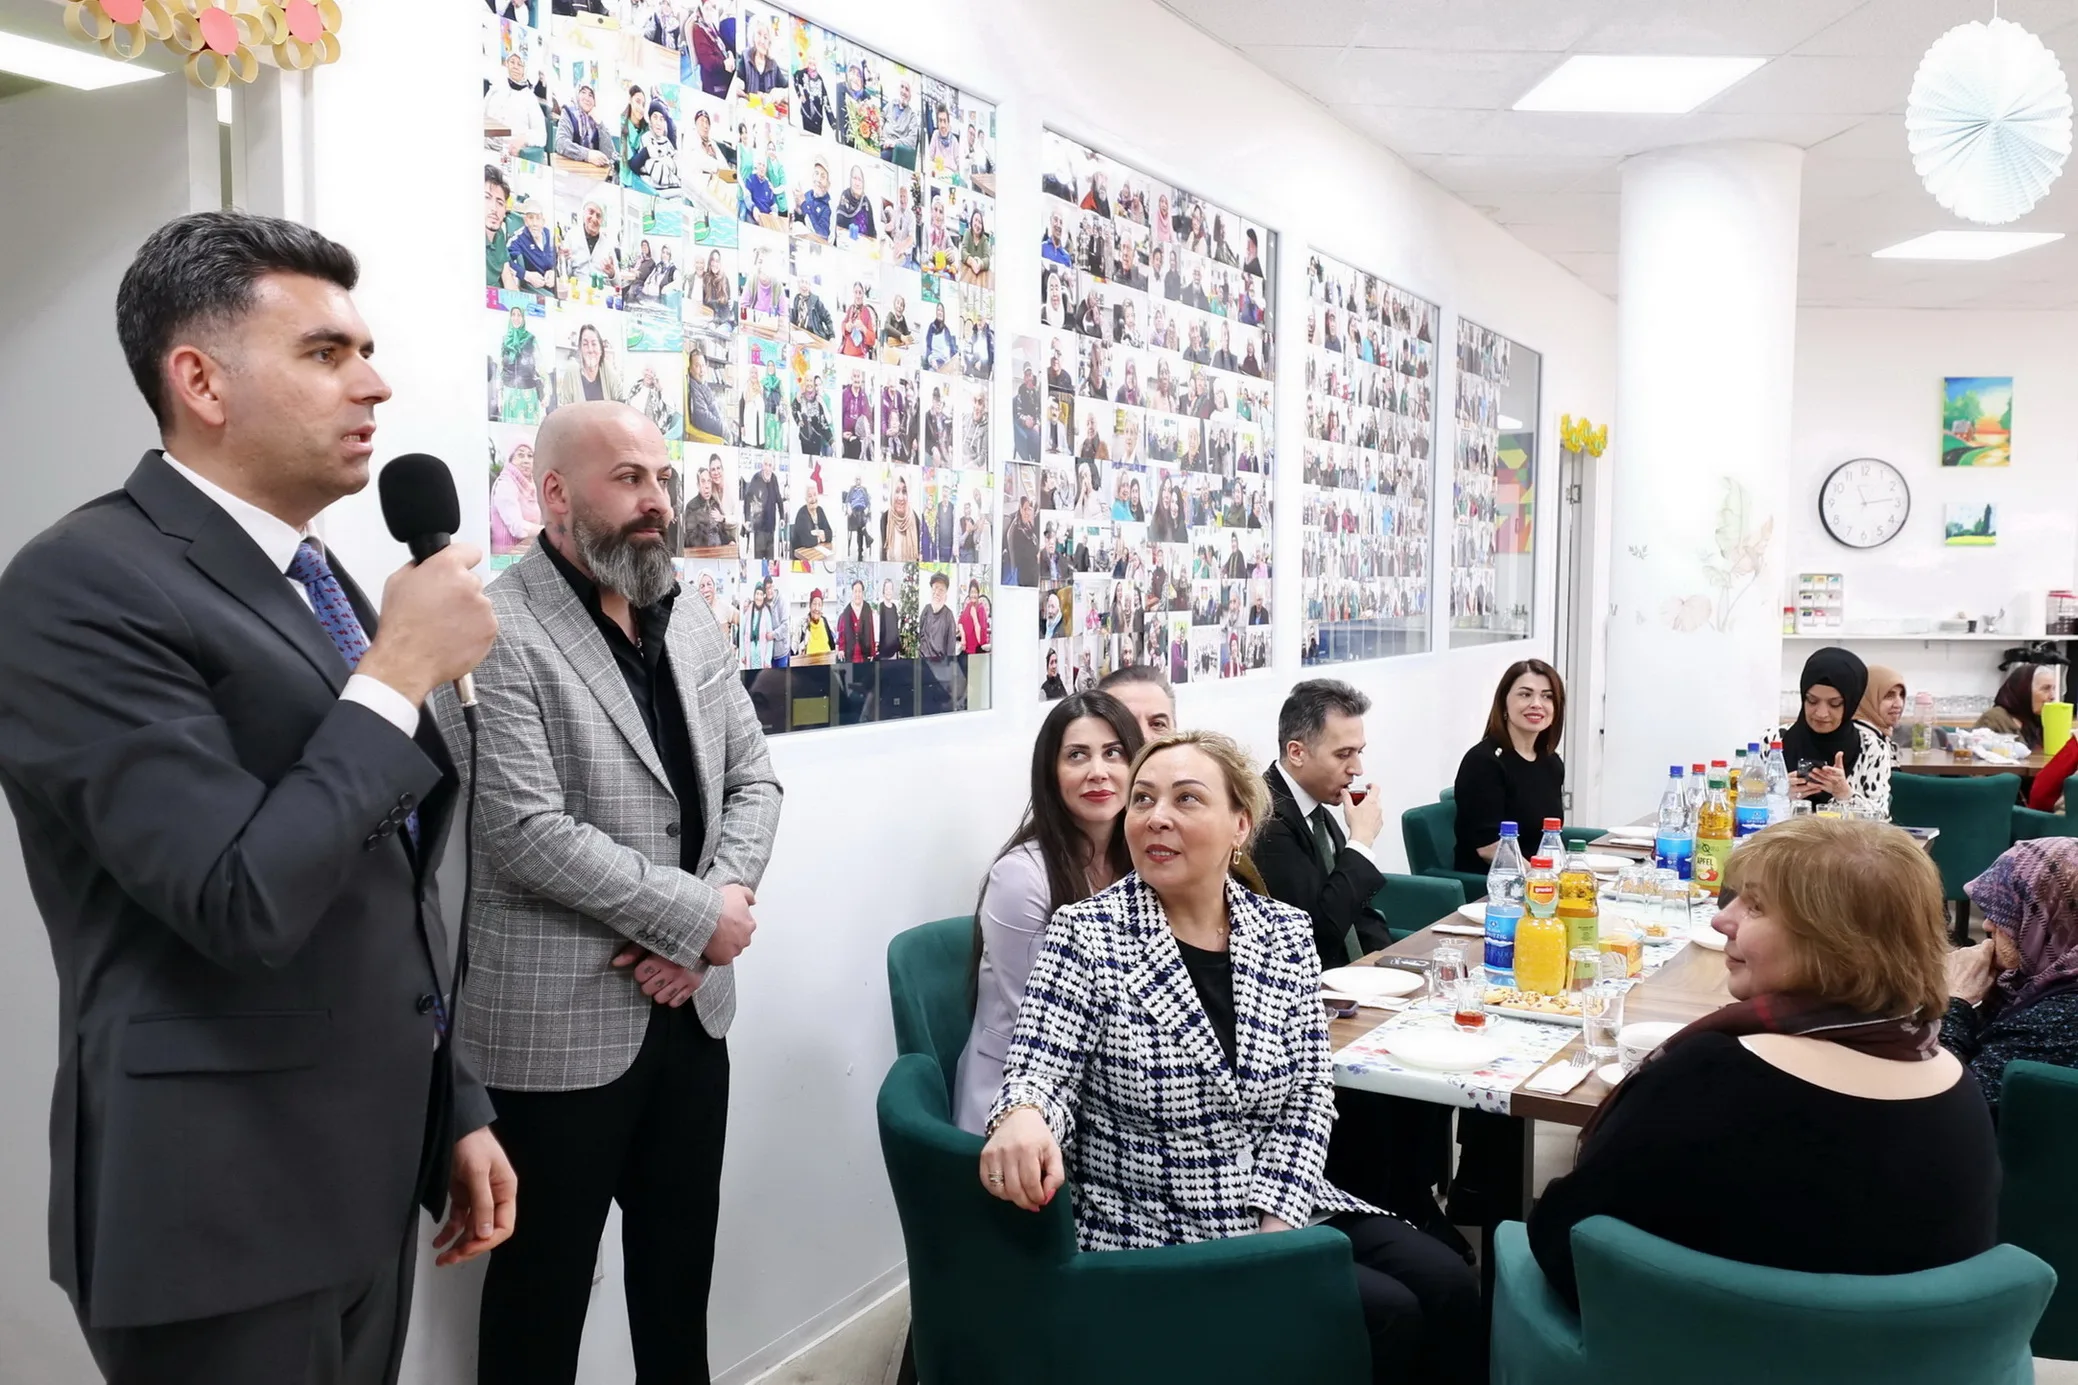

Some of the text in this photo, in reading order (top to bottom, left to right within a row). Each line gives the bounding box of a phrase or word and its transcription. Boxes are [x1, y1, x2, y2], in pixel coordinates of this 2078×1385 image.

[1846, 471, 1852, 481] 11
[1861, 465, 1870, 476] 12
[1834, 482, 1844, 494] 10
[1889, 481, 1896, 492] 2
[1828, 498, 1835, 508] 9
[1894, 497, 1901, 508] 3
[1833, 514, 1839, 525] 8
[1888, 514, 1895, 524] 4
[1846, 526, 1852, 537] 7
[1861, 530, 1867, 541] 6
[1876, 525, 1883, 537] 5
